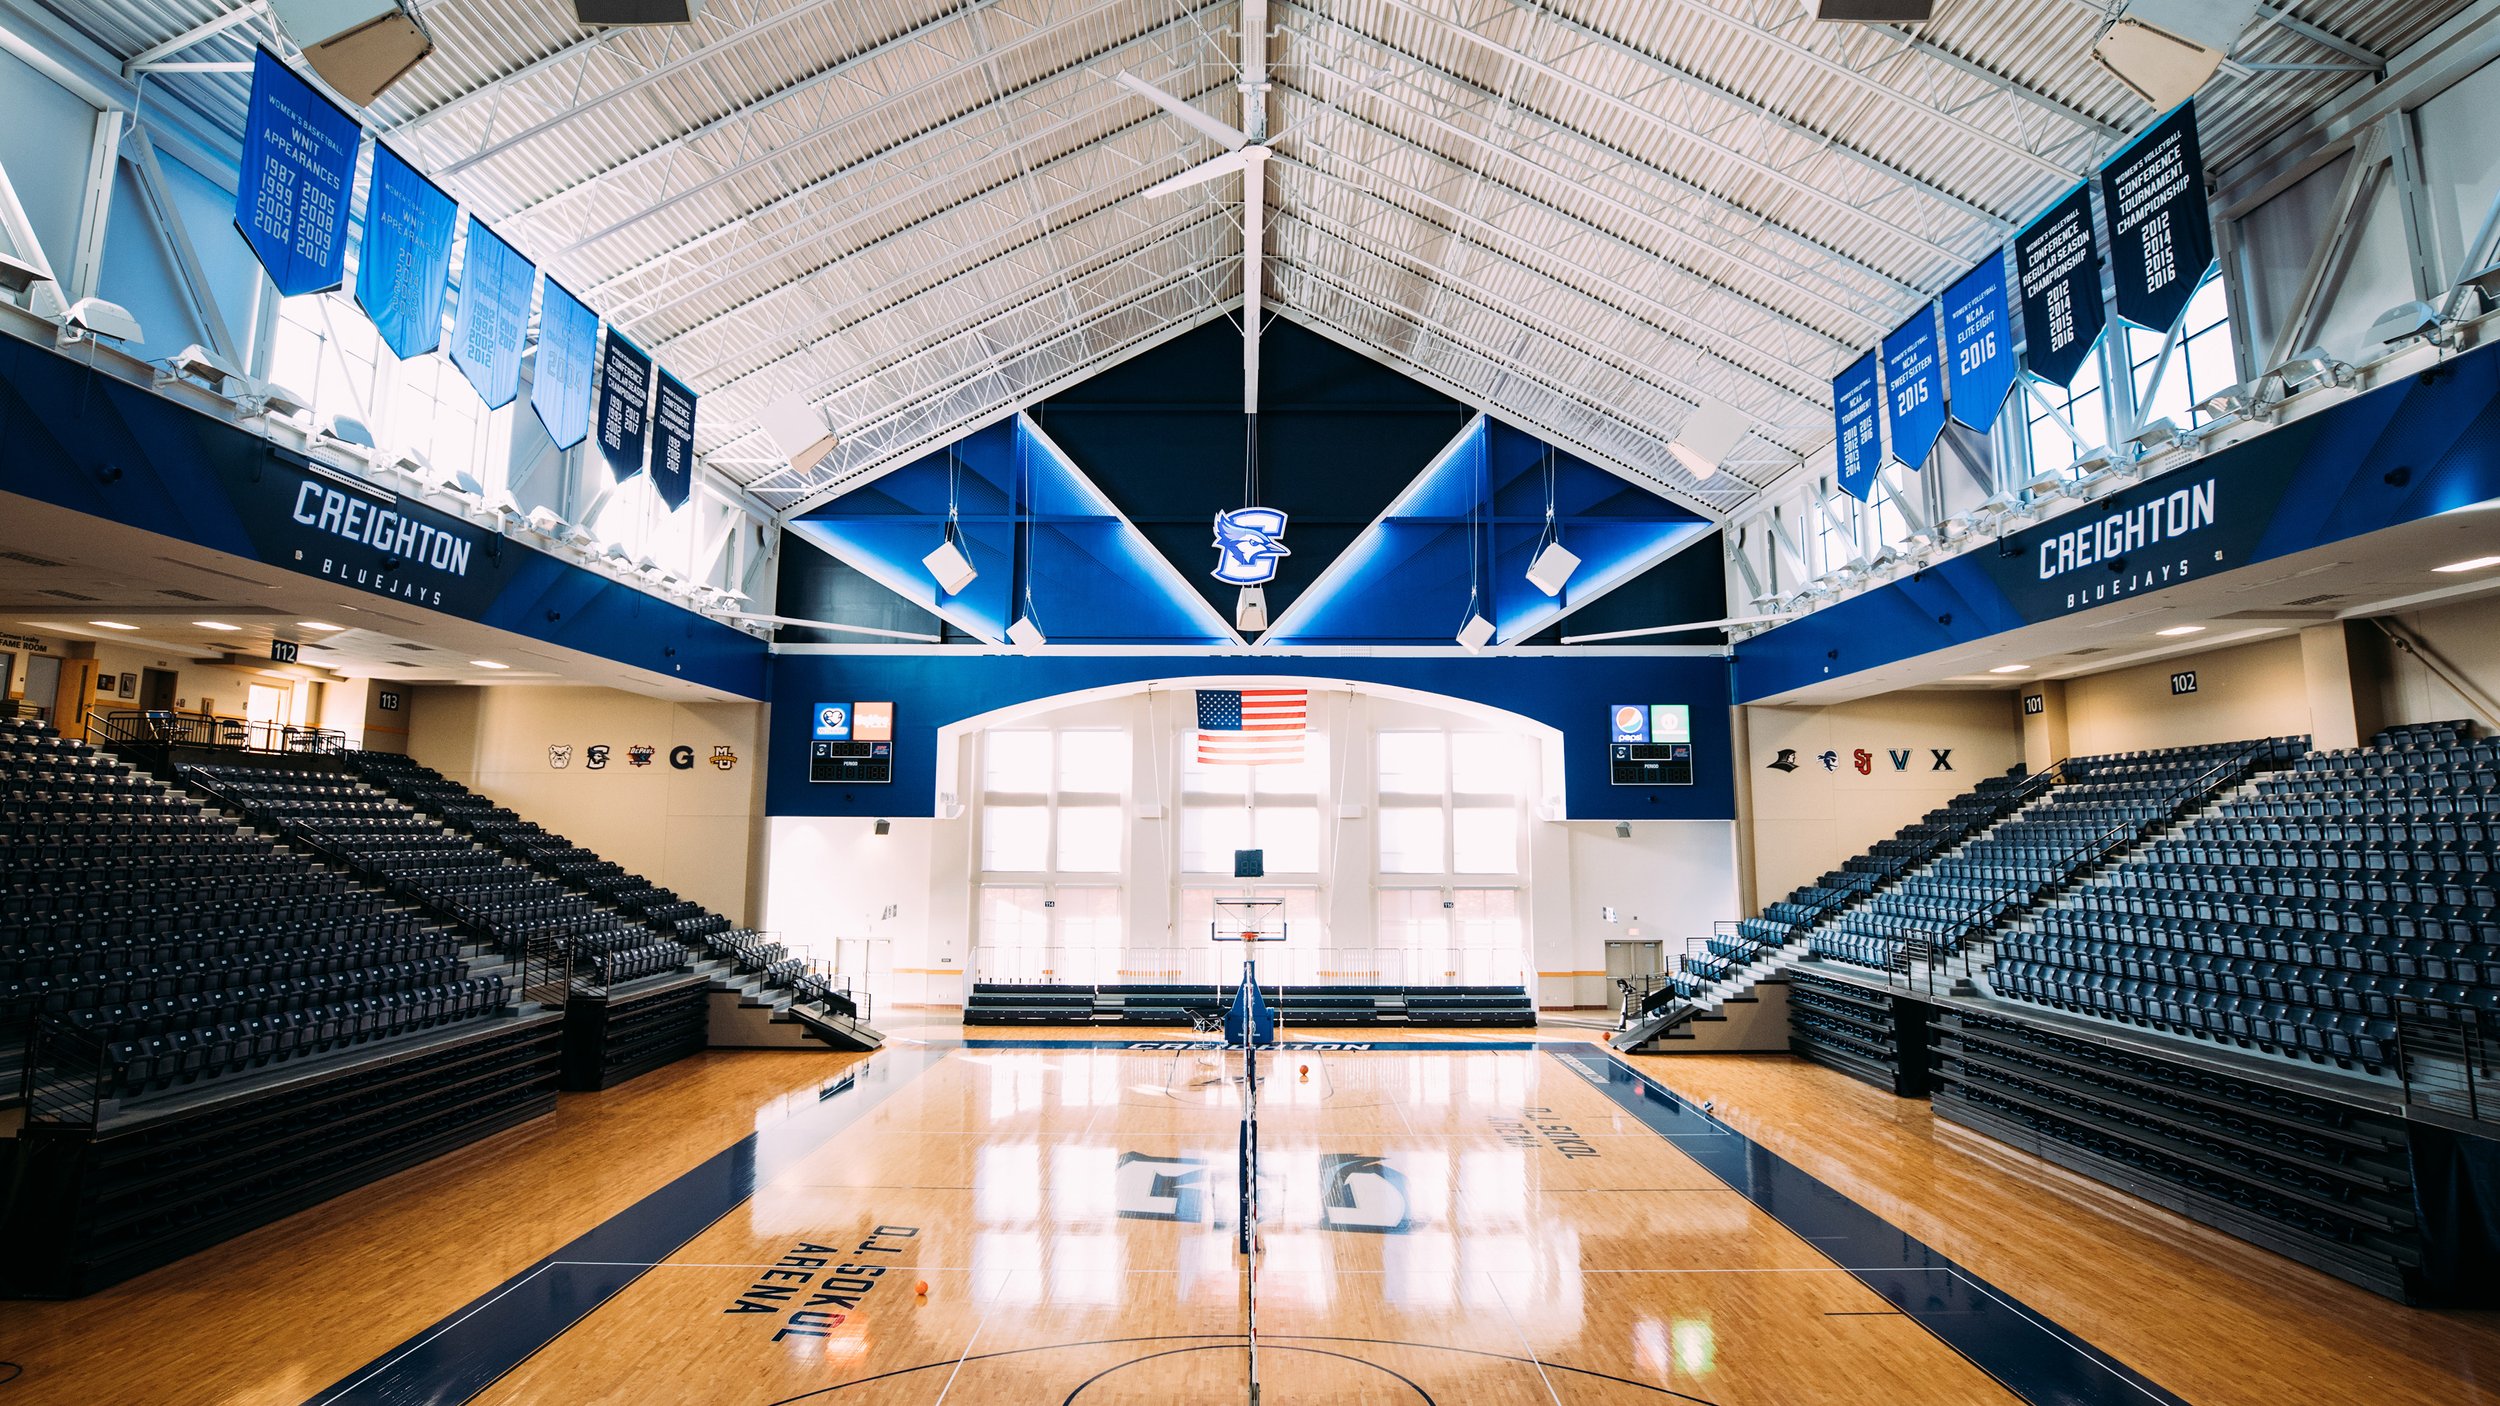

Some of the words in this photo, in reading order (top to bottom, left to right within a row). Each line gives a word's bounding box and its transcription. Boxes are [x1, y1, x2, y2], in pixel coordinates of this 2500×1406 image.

[268, 94, 302, 125] WOMEN'S
[303, 121, 343, 156] BASKETBALL
[291, 127, 320, 156] WNIT
[264, 128, 340, 190] APPEARANCES
[2115, 158, 2144, 186] WOMEN'S
[2143, 130, 2182, 165] VOLLEYBALL
[2118, 144, 2182, 200] CONFERENCE
[265, 155, 296, 186] 1987
[302, 181, 335, 216] 2005
[2119, 160, 2183, 216] TOURNAMENT
[262, 173, 293, 206] 1999
[300, 199, 333, 233] 2008
[2117, 174, 2190, 235] CHAMPIONSHIP
[258, 191, 292, 226] 2003
[298, 218, 331, 251] 2009
[403, 210, 424, 232] WNIT
[2026, 232, 2048, 253] WOMEN'S
[2048, 208, 2080, 236] VOLLEYBALL
[2141, 210, 2170, 243] 2012
[255, 210, 289, 245] 2004
[297, 237, 327, 267] 2010
[381, 212, 441, 262] APPEARANCES
[2028, 221, 2079, 268] CONFERENCE
[2143, 228, 2171, 260] 2014
[2022, 253, 2057, 287] REGULAR
[2057, 230, 2090, 262] SEASON
[2027, 248, 2087, 299] CHAMPIONSHIP
[2145, 245, 2174, 277] 2015
[2047, 279, 2069, 306] 2012
[2147, 262, 2176, 294] 2016
[1952, 301, 1971, 319] WOMEN'S
[1971, 283, 1997, 306] VOLLEYBALL
[1966, 304, 1984, 325] NCAA
[2048, 295, 2071, 322] 2014
[473, 313, 494, 338] 1994
[499, 332, 516, 352] 2017
[474, 299, 495, 324] 1992
[500, 316, 518, 337] 2013
[1958, 324, 1975, 344] ELITE
[1976, 310, 1995, 332] EIGHT
[2050, 310, 2072, 337] 2015
[469, 329, 494, 354] 2002
[1960, 331, 1996, 376] 2016
[2051, 325, 2074, 353] 2016
[468, 345, 492, 368] 2012
[611, 355, 642, 386] CONFERENCE
[1902, 352, 1917, 370] NCAA
[606, 363, 628, 385] REGULAR
[628, 382, 646, 401] SEASON
[1890, 371, 1909, 391] SWEET
[1909, 354, 1932, 379] SIXTEEN
[608, 377, 644, 408] CHAMPIONSHIP
[663, 395, 690, 420] CONFERENCE
[1850, 393, 1862, 409] NCAA
[1898, 377, 1928, 417] 2015
[608, 408, 622, 425] 1992
[624, 418, 638, 435] 2017
[610, 394, 622, 411] 1991
[625, 405, 640, 424] 2013
[662, 405, 690, 430] TOURNAMENT
[1842, 398, 1871, 425] TOURNAMENT
[605, 430, 620, 450] 2003
[606, 418, 621, 438] 2002
[660, 415, 691, 441] CHAMPIONSHIP
[669, 435, 681, 451] 1992
[1844, 425, 1857, 443] 2010
[1860, 415, 1872, 433] 2015
[1844, 437, 1858, 455] 2012
[1861, 427, 1873, 445] 2016
[1845, 449, 1859, 466] 2013
[1845, 461, 1860, 478] 2014
[292, 480, 472, 577] CREIGHTON
[2039, 478, 2216, 580] CREIGHTON
[322, 558, 441, 606] BLUEJAYS
[2066, 559, 2189, 609] BLUEJAYS
[22, 641, 48, 653] ROOM
[274, 643, 296, 662] 112
[2172, 673, 2196, 692] 102
[381, 693, 398, 709] 113
[2026, 697, 2042, 713] 101
[669, 745, 695, 770] G
[1887, 748, 1913, 772] V
[1929, 748, 1956, 772] X
[1536, 1124, 1601, 1160] SOKOL
[723, 1242, 839, 1314] ARENA
[771, 1263, 887, 1342] SOKOL
